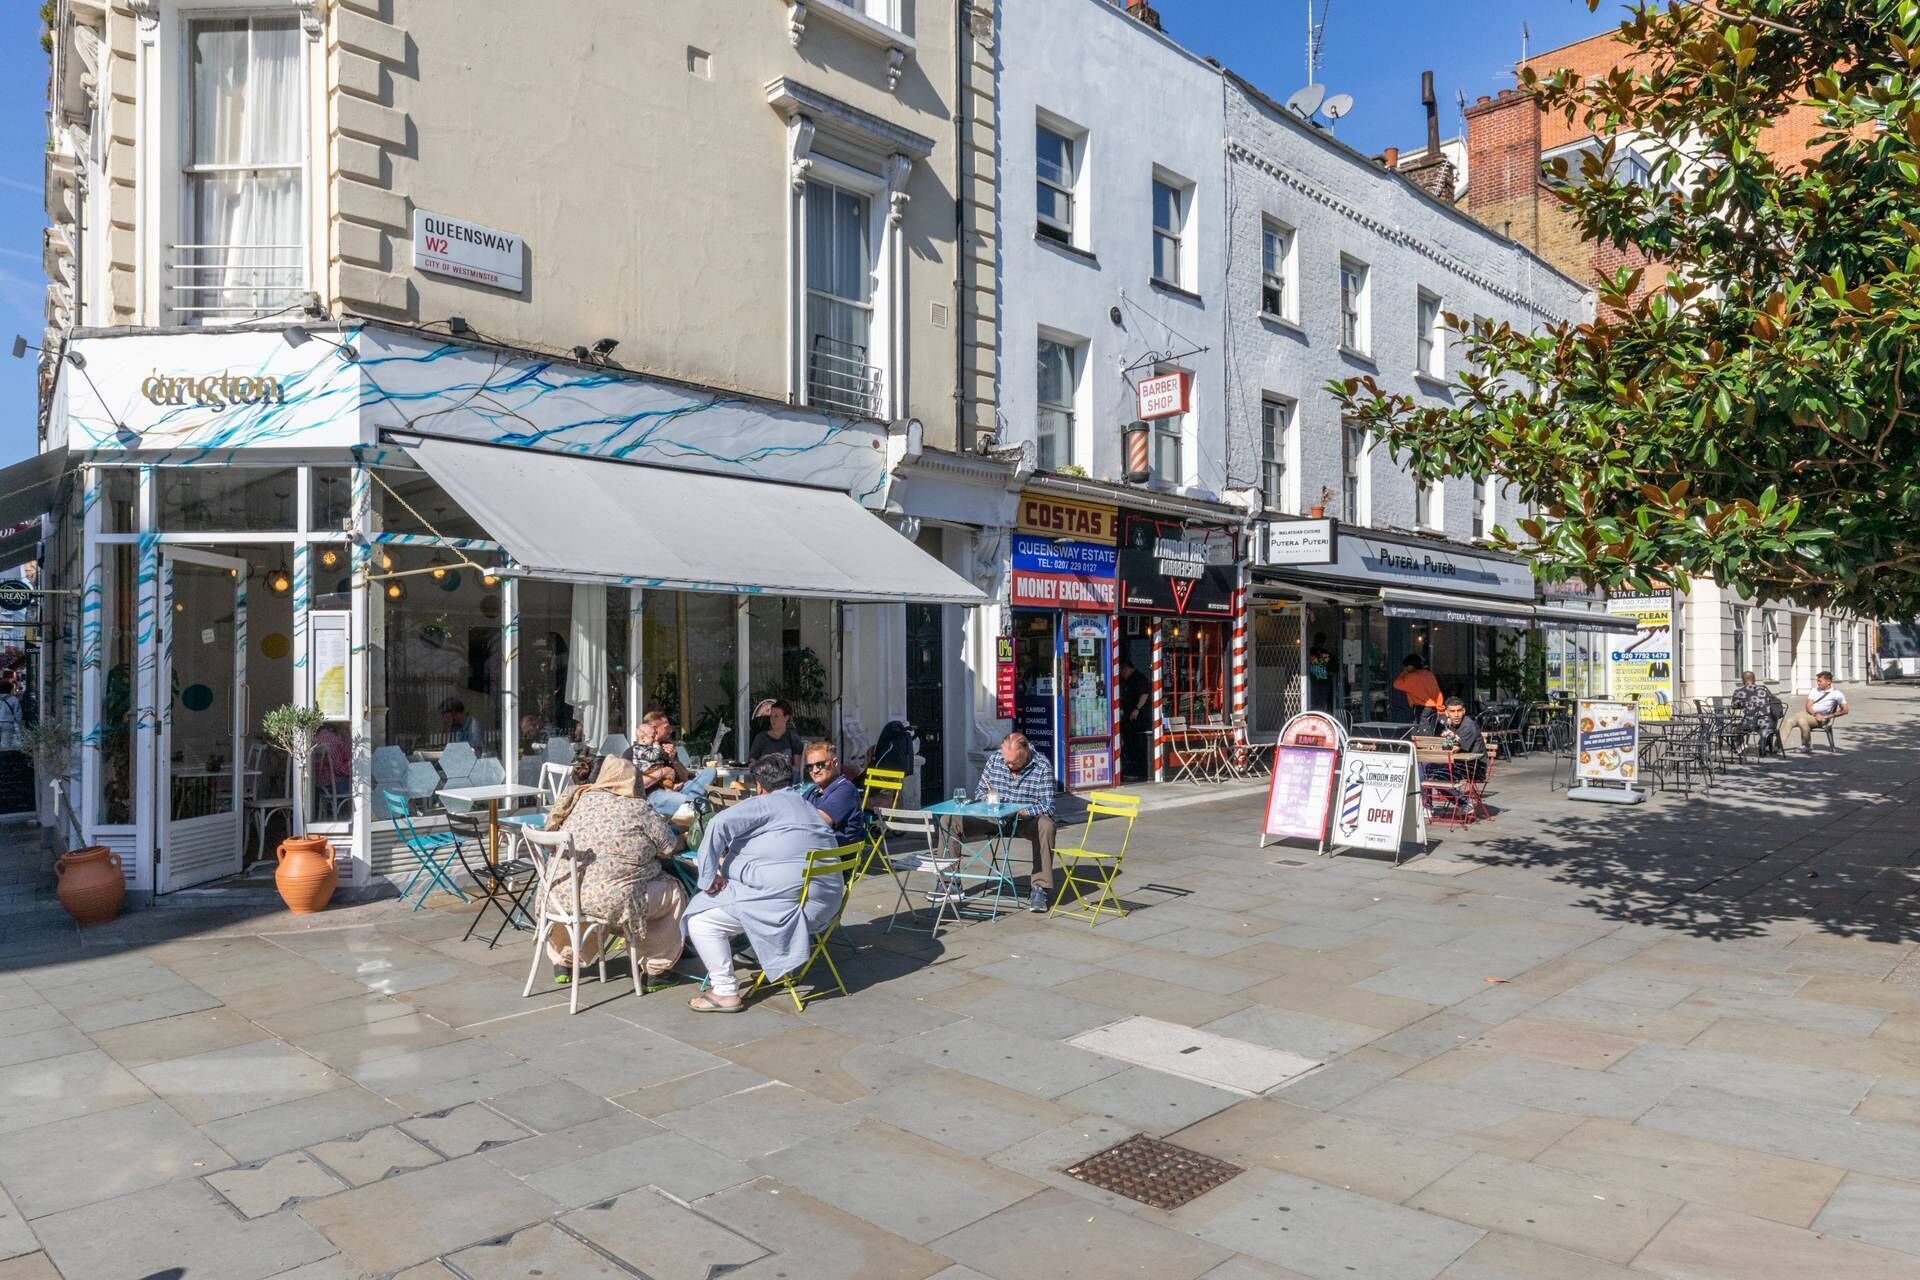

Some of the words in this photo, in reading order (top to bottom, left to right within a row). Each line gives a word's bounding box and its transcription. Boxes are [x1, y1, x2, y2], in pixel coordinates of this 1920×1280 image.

[425, 217, 514, 253] QUEENSWAY
[425, 235, 449, 255] W2
[425, 258, 440, 269] CITY
[442, 263, 451, 272] OF
[452, 265, 499, 283] WESTMINSTER
[1142, 378, 1178, 398] BARBER
[1147, 395, 1173, 412] SHOP
[1025, 501, 1102, 536] COSTAS
[1270, 539, 1300, 547] PUTERA
[1302, 537, 1329, 546] PUTERI
[1018, 540, 1080, 560] QUEENSWAY
[1081, 548, 1116, 564] ESTATE
[1037, 557, 1054, 569] TEL:
[1053, 559, 1070, 571] 0207
[1069, 561, 1082, 572] 229
[1082, 562, 1098, 573] 0127
[1379, 547, 1420, 572] PUTERA
[1423, 554, 1457, 577] PUTERI
[1016, 576, 1058, 600] MONEY
[1058, 580, 1115, 603] EXCHANGE
[1638, 612, 1669, 620] CLEAN
[999, 638, 1013, 657] 0%
[1025, 706, 1046, 714] CAMBIO
[1025, 718, 1048, 726] CHANGE
[1025, 728, 1054, 737] EXCHANGE
[1365, 772, 1389, 781] LONDON
[1389, 774, 1405, 784] BASE
[1365, 780, 1404, 789] BARBERSHOP
[1367, 807, 1394, 825] OPEN
